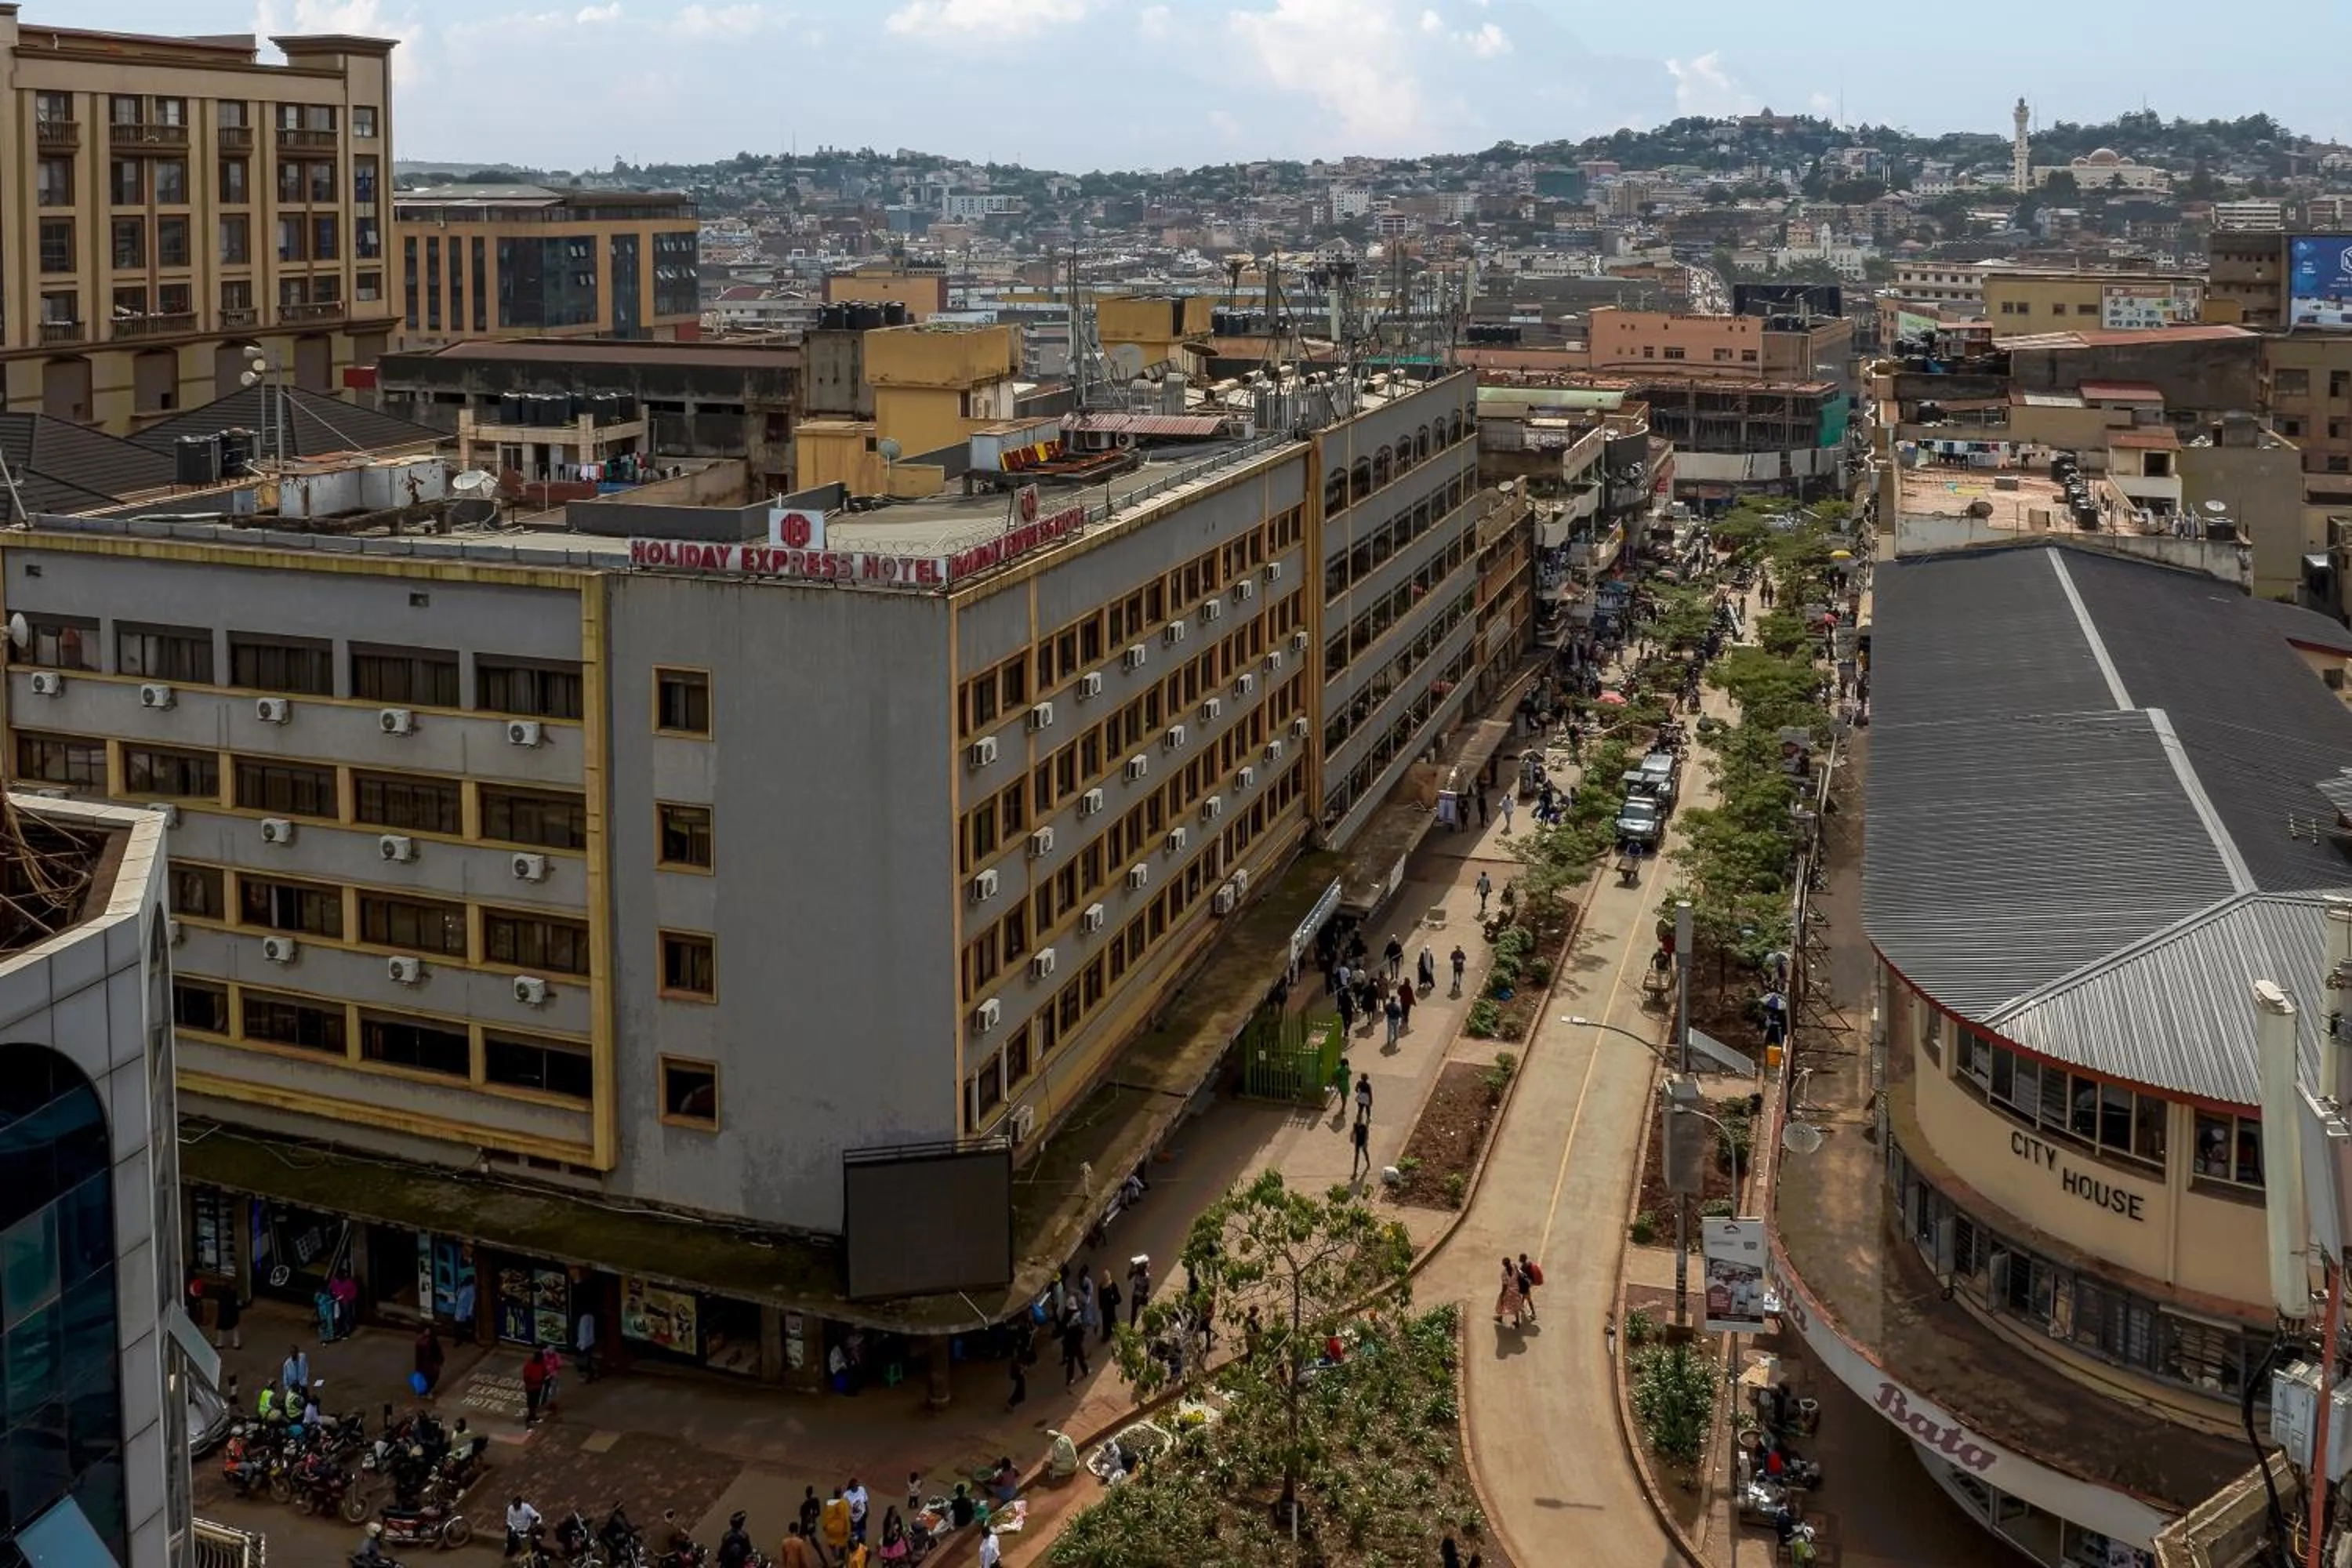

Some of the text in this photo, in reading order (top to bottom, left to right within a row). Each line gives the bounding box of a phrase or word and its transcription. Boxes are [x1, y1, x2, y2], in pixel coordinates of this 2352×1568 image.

[631, 539, 944, 583] HOLIDAY EXPRESS HOTEL
[2011, 1131, 2145, 1222] CITY HOUSE
[1774, 1272, 1808, 1331] ata
[1873, 1382, 1997, 1471] Bata
